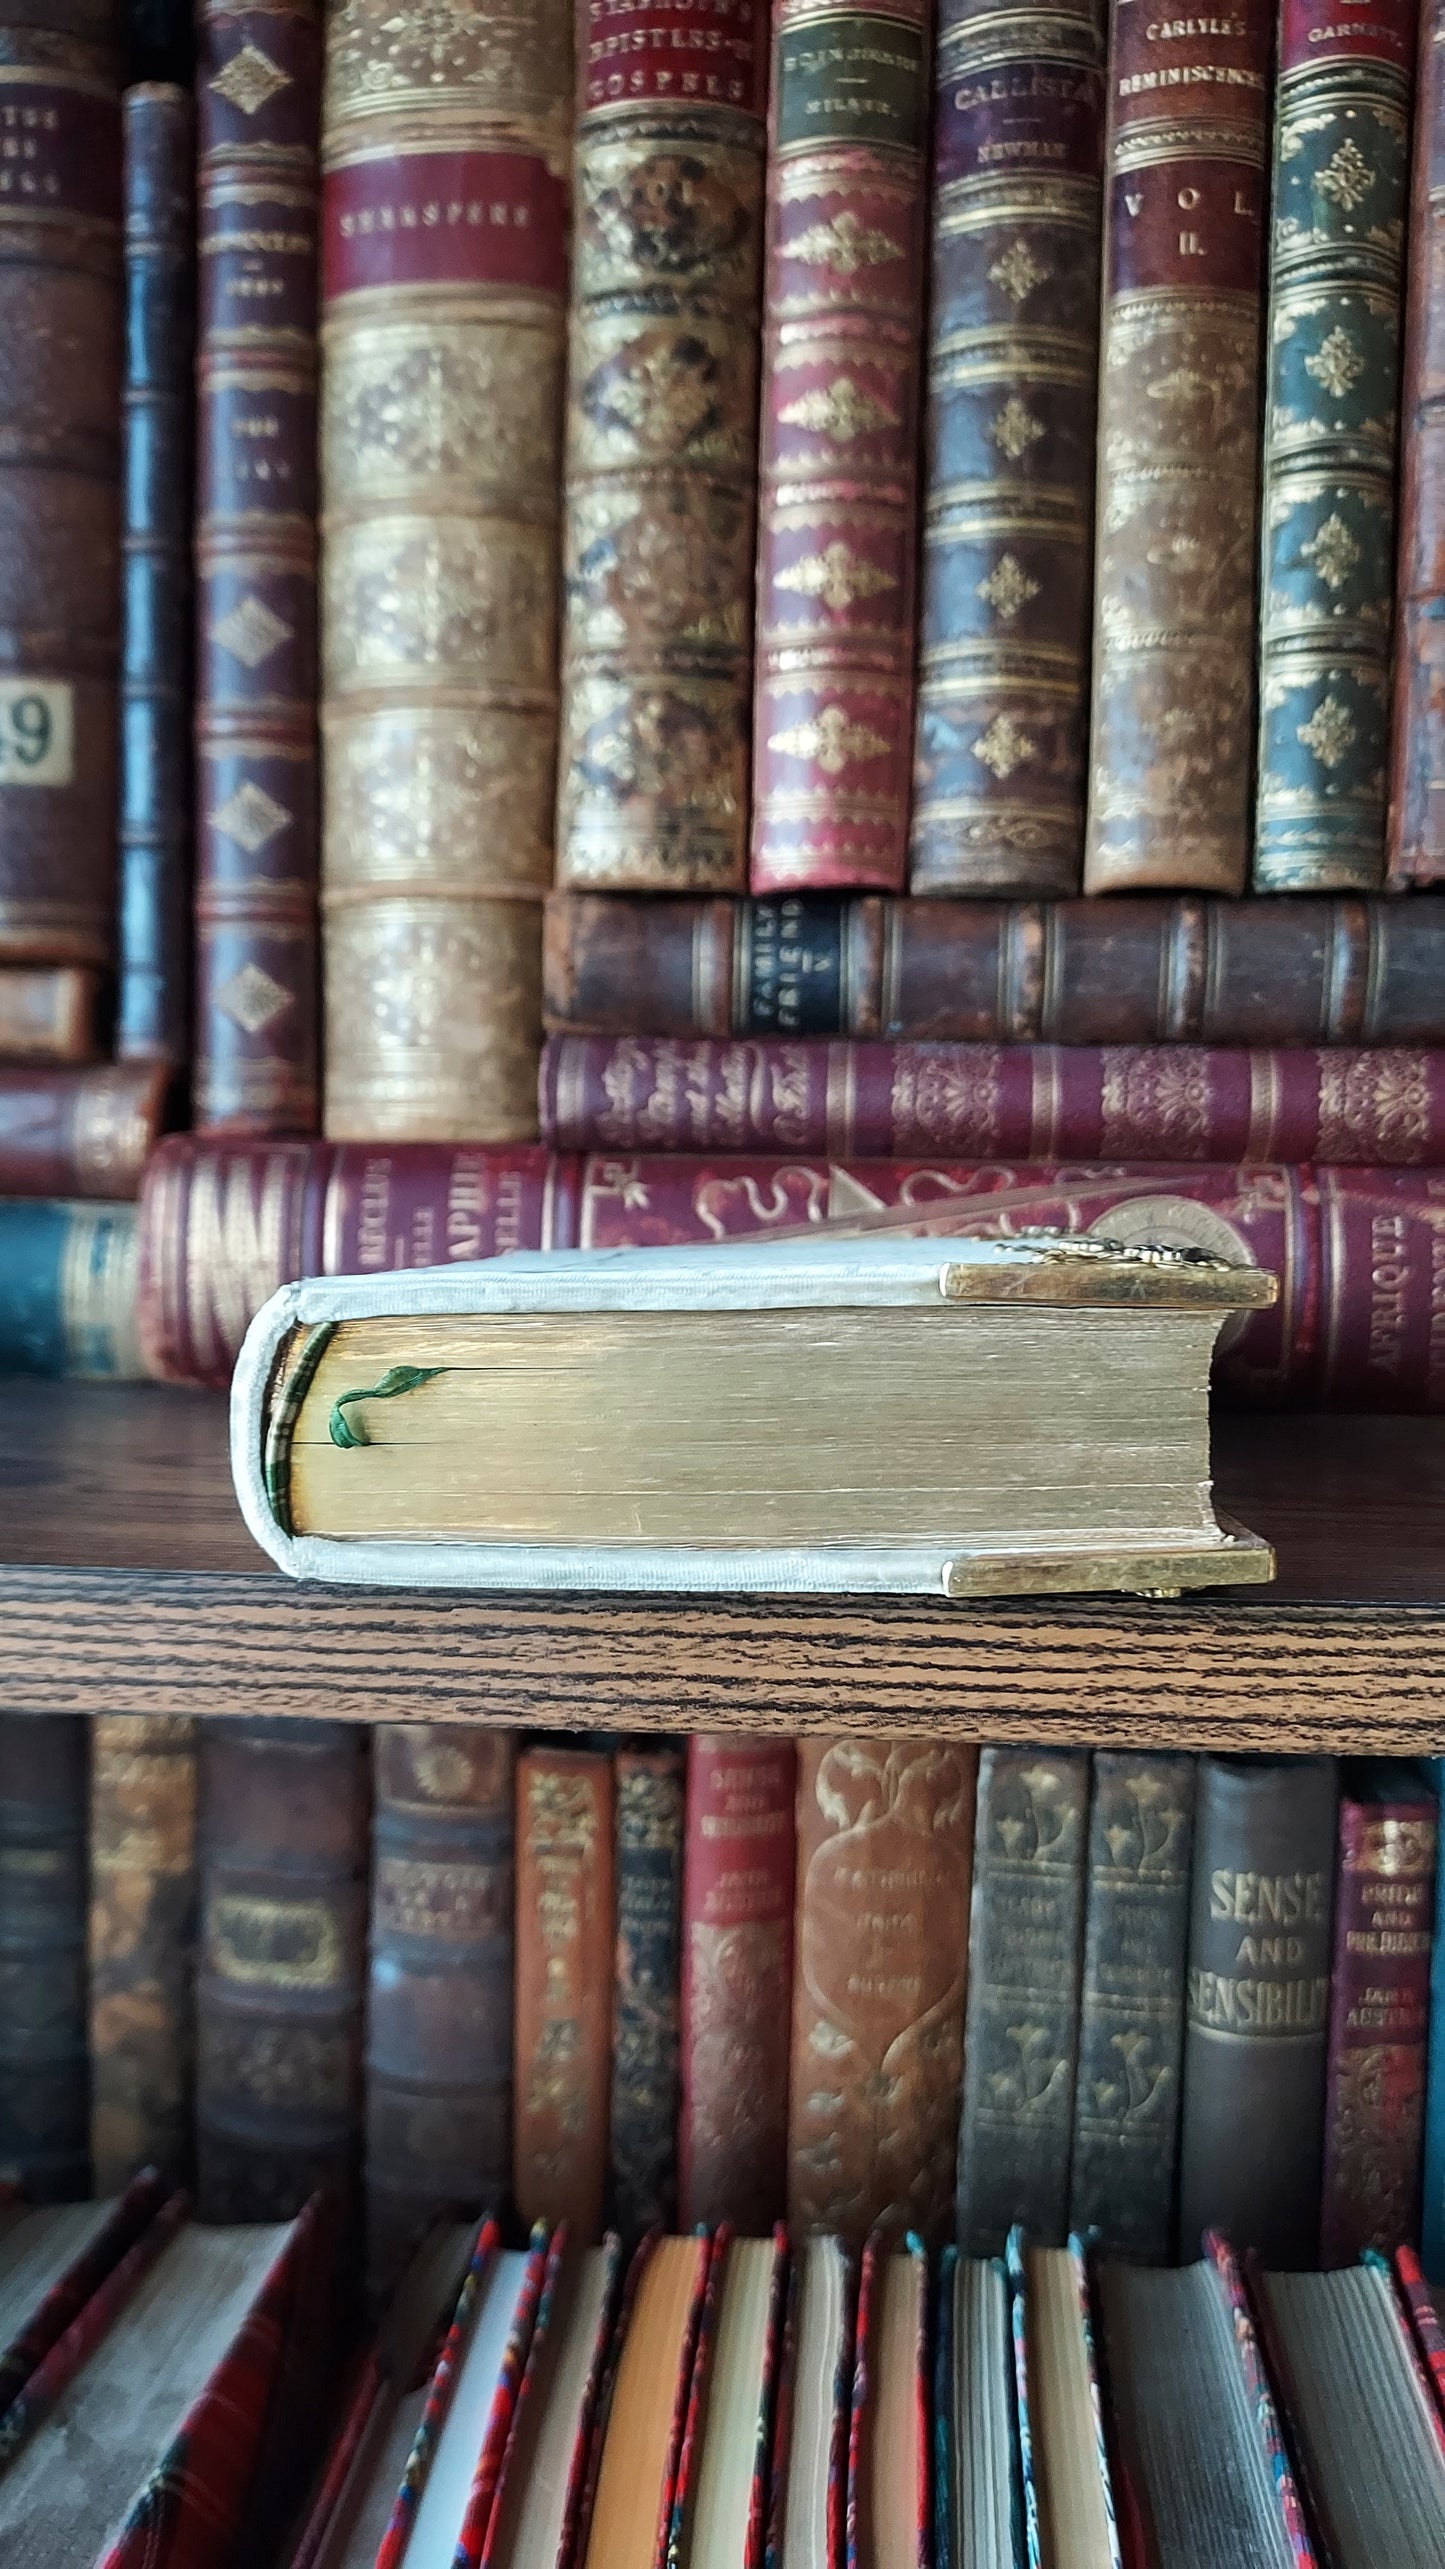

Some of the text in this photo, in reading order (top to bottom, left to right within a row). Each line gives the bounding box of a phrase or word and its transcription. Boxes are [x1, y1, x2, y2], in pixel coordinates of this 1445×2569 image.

[777, 899, 804, 1027] FRIEND
[1367, 1214, 1411, 1376] AFRIQUE
[1210, 1868, 1324, 1928] SENSE
[1235, 1934, 1304, 1967] AND
